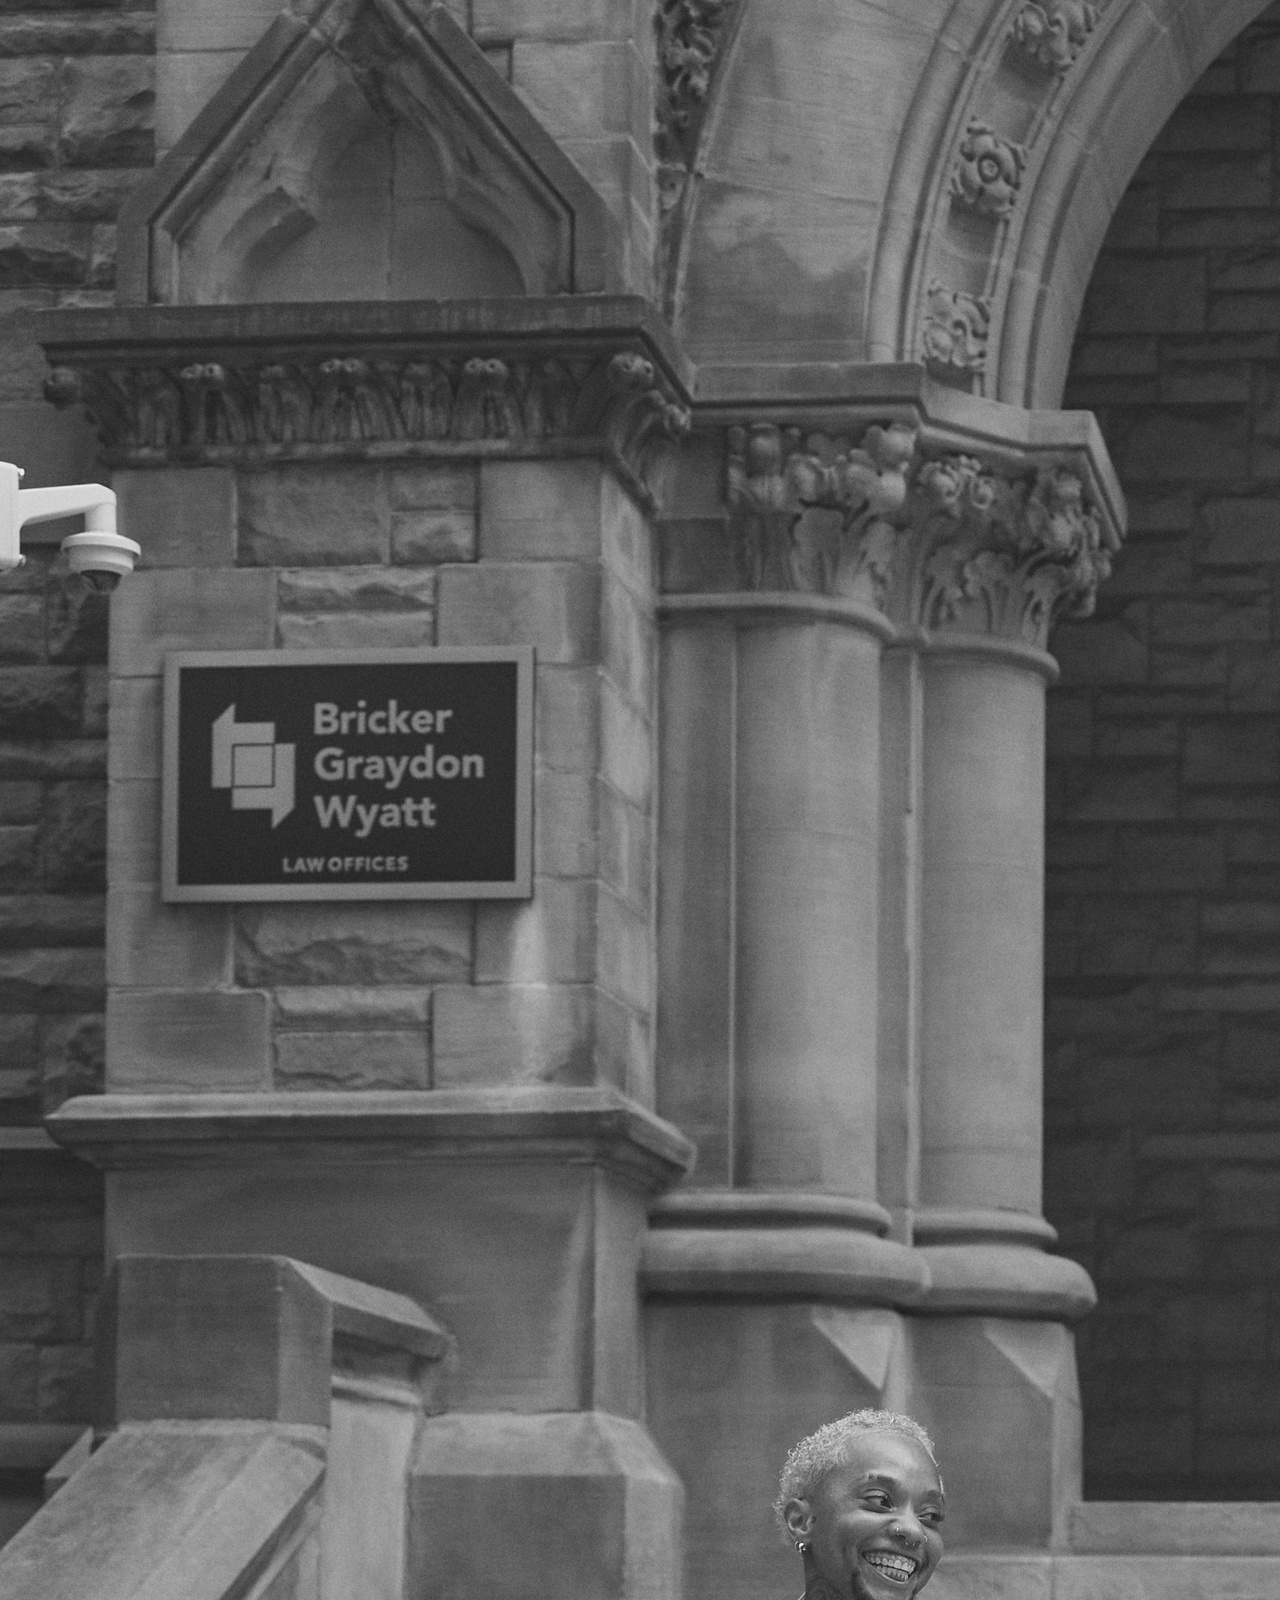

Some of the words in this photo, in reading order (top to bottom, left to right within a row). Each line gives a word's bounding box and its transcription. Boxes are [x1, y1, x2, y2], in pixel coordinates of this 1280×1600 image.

[313, 699, 452, 735] Bricker
[313, 744, 484, 789] Graydon
[313, 795, 436, 837] Wyatt
[282, 857, 325, 873] LAW
[327, 856, 409, 872] OFFICES
